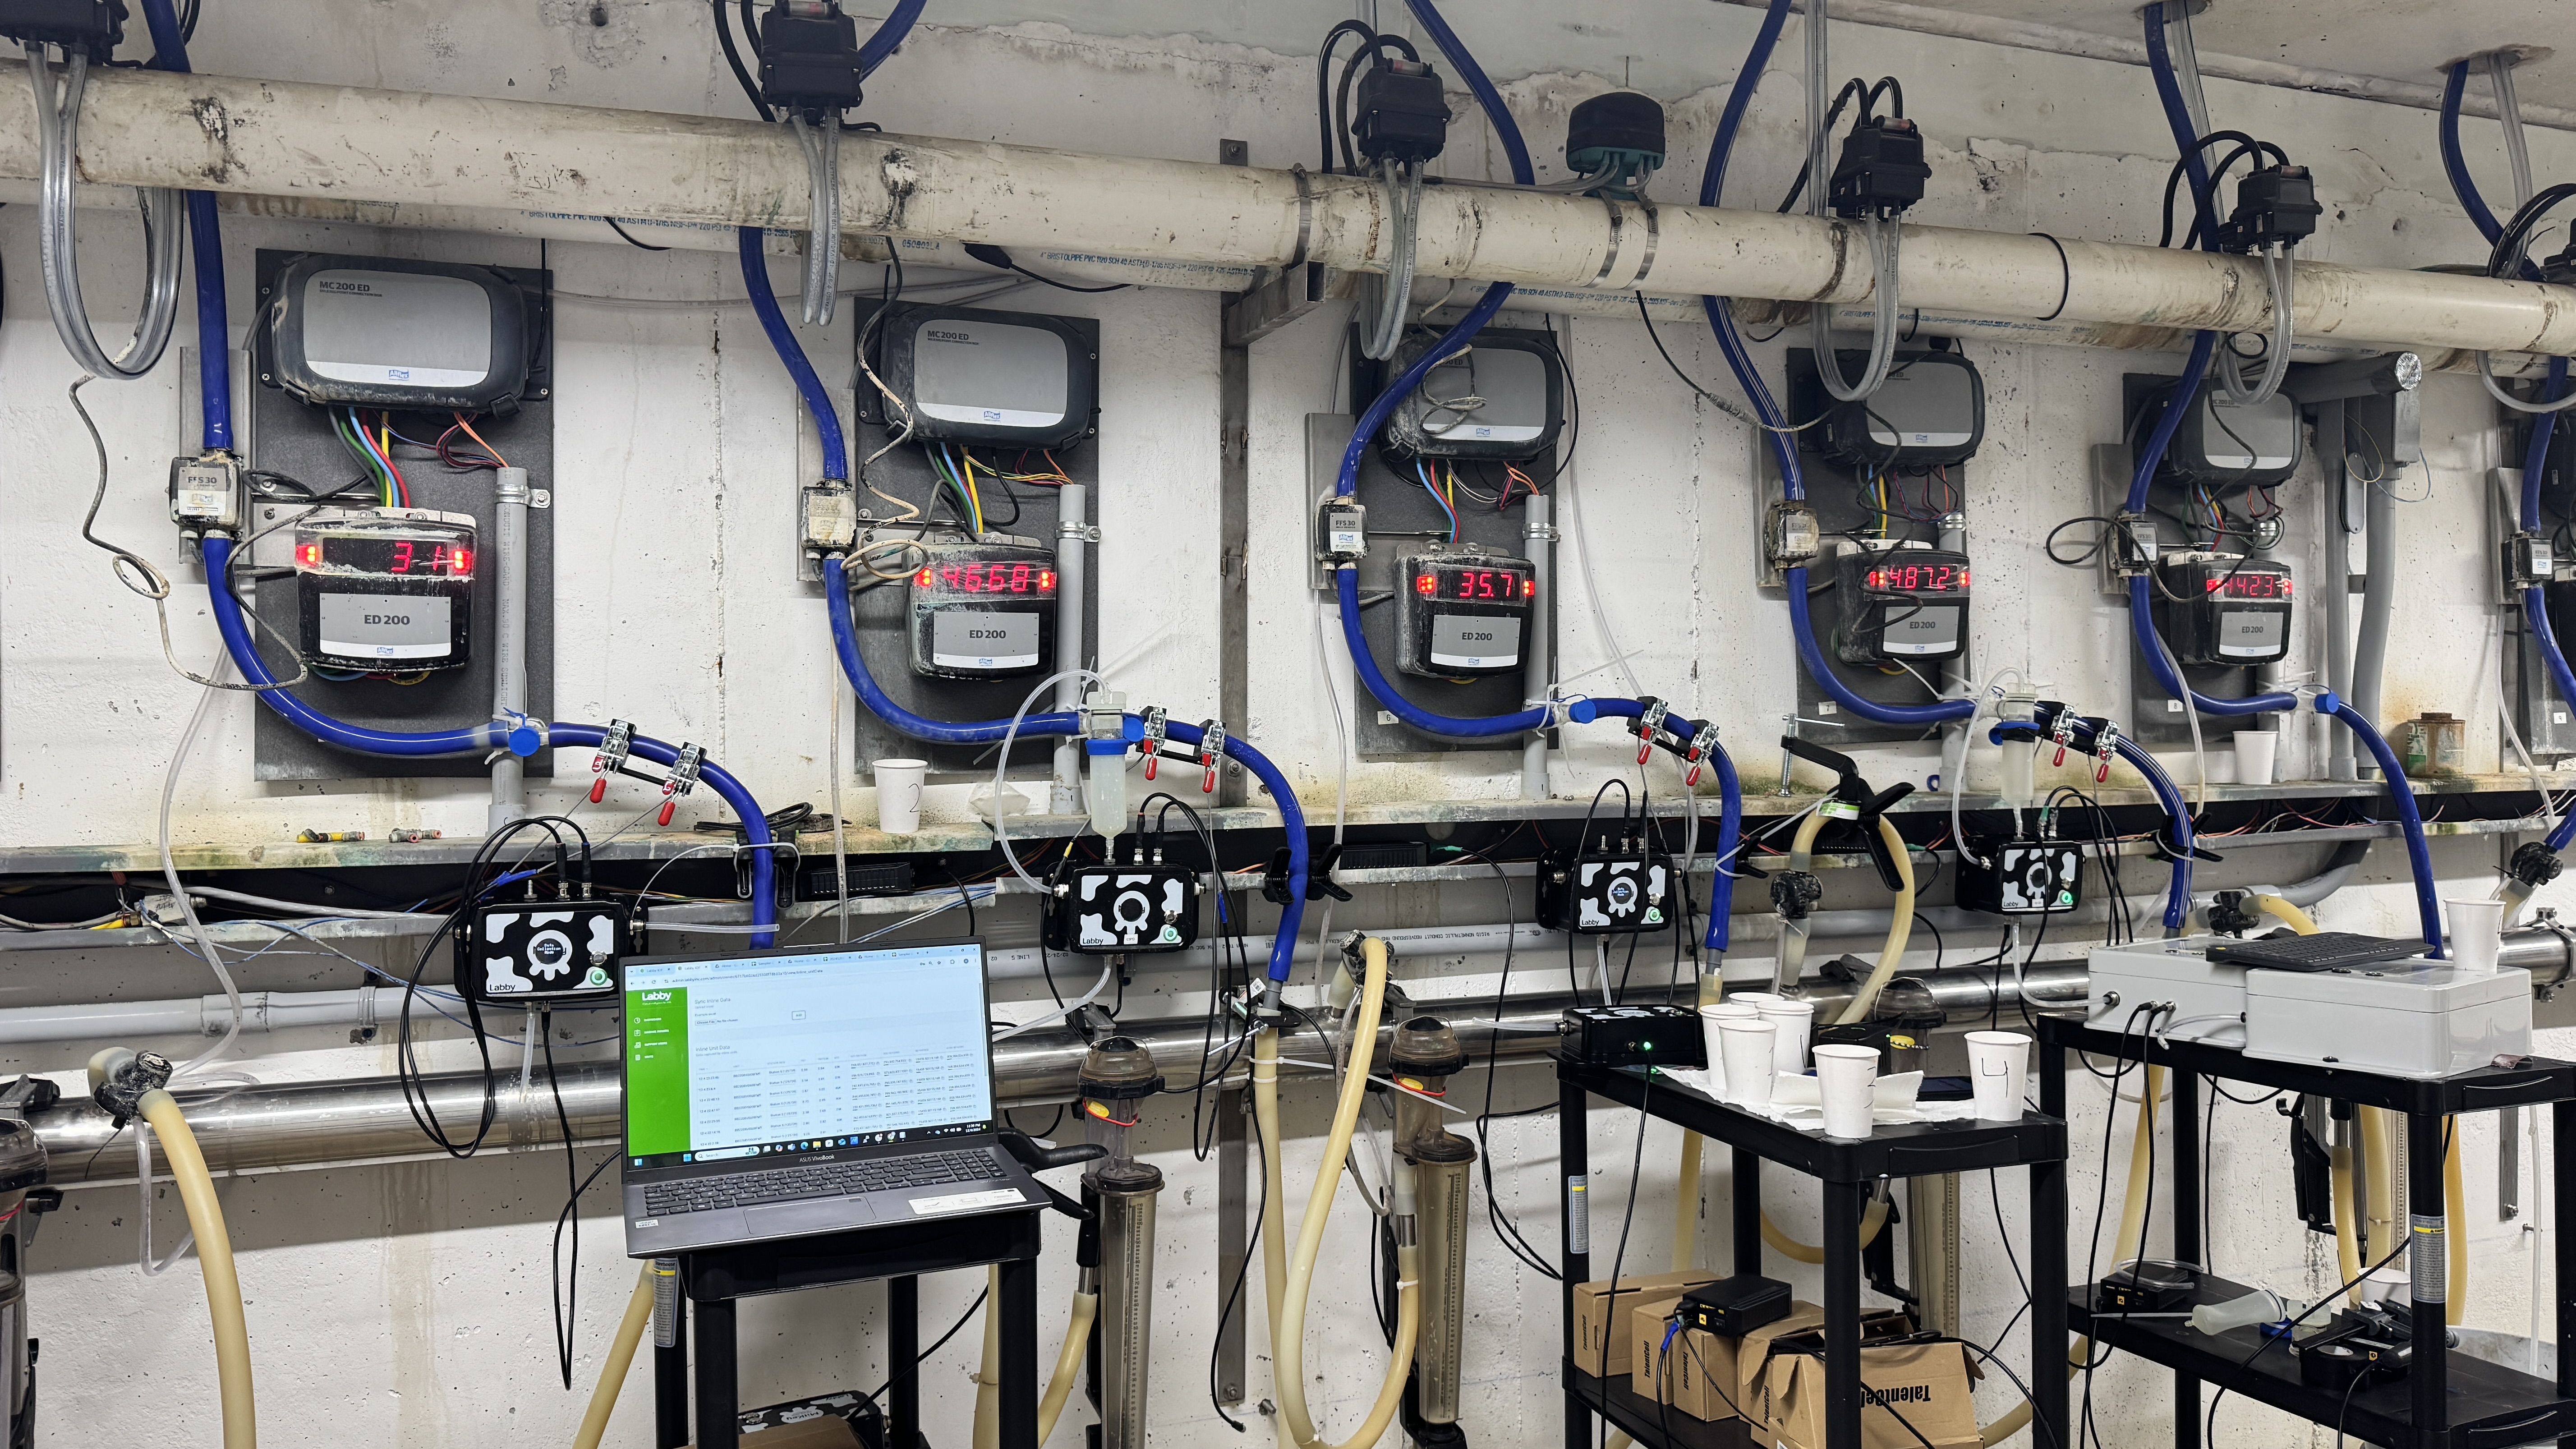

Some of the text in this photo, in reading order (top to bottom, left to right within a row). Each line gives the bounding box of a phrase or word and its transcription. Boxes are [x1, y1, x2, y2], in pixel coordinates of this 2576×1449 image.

[319, 281, 370, 292] MC 200 ED
[927, 330, 940, 339] MC
[941, 331, 957, 340] 200
[364, 614, 411, 626] ED 200
[1920, 621, 1936, 629] 200
[969, 630, 1007, 639] ED 200
[1462, 632, 1493, 641] ED 200
[908, 782, 920, 813] 2
[1082, 938, 1104, 946] Labby
[489, 984, 516, 993] Labby
[642, 991, 672, 1001] Labby
